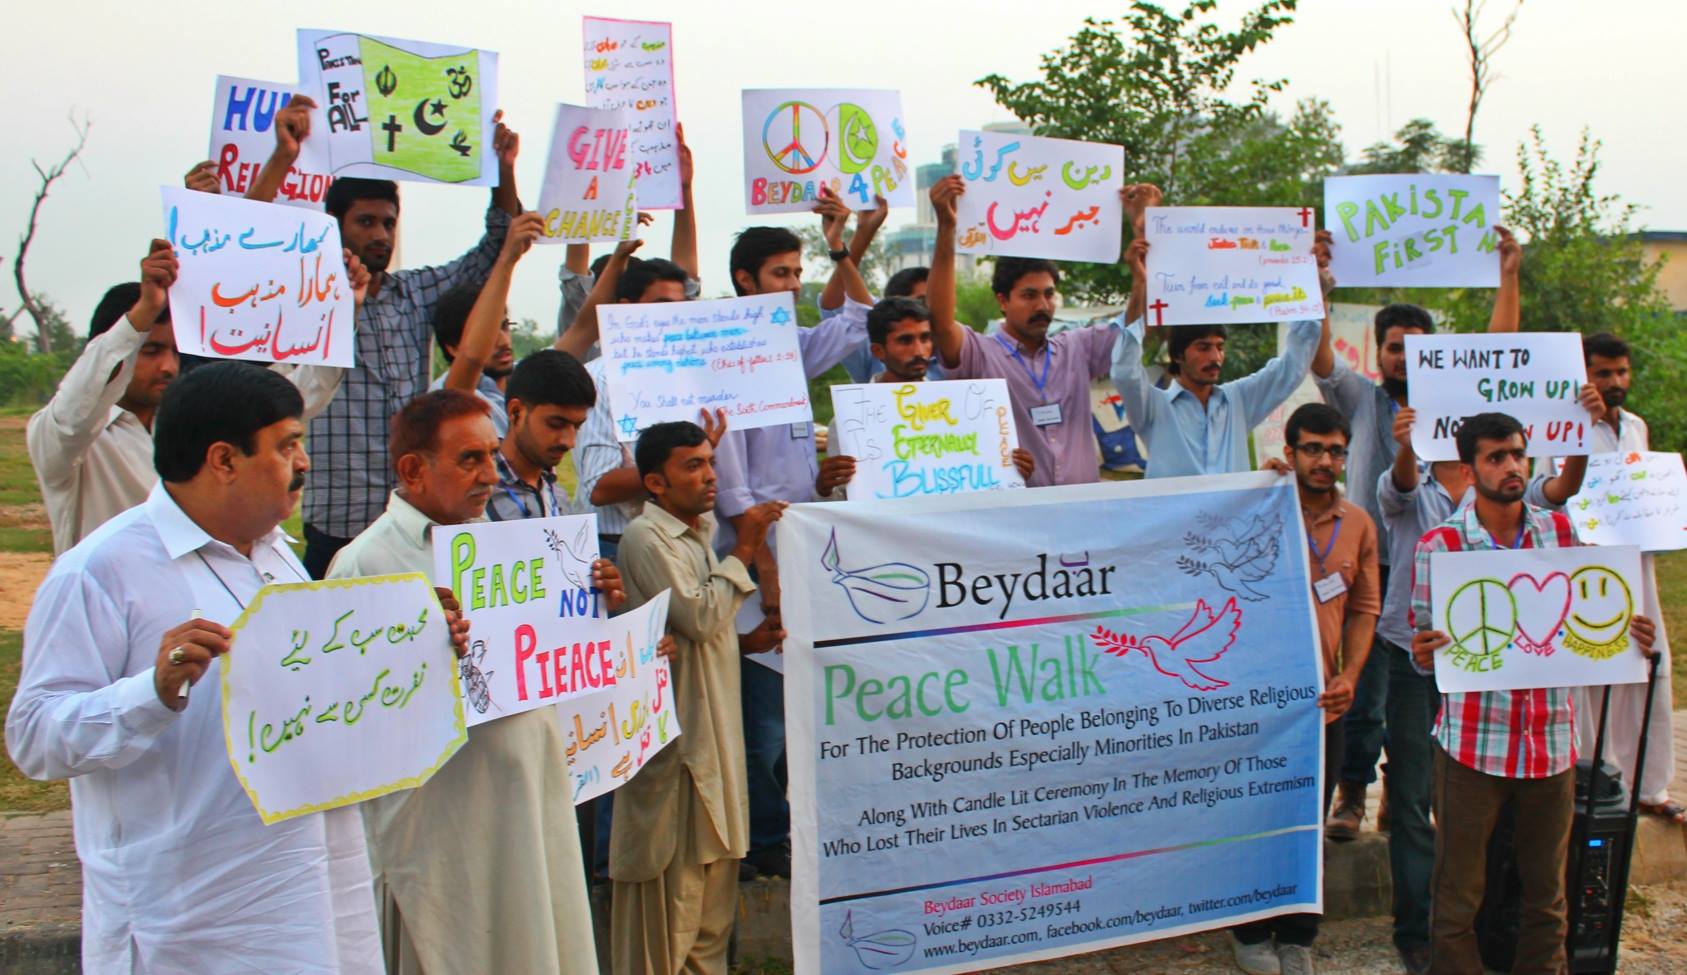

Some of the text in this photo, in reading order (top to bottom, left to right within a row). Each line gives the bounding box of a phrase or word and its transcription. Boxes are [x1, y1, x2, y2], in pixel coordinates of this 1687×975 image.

[223, 86, 293, 133] HU
[567, 126, 628, 172] GIVE
[961, 135, 1112, 191] دین میں کوئی
[217, 143, 336, 203] REGIO
[582, 175, 599, 201] A
[847, 172, 869, 204] 4
[544, 207, 622, 241] CHANCE
[986, 190, 1101, 242] جبر نہیں
[210, 252, 341, 314] ہمارا مذہب
[1418, 349, 1531, 370] WE WANT TO
[892, 383, 959, 432] GIVER
[1477, 378, 1580, 404] GROW UP!
[1432, 415, 1466, 440] NO
[1545, 420, 1584, 448] UP!
[450, 531, 546, 611] PEACE
[933, 552, 1116, 621] Beydaar
[386, 608, 428, 645] محبت
[559, 587, 602, 619] NOT
[321, 608, 355, 655] کے
[349, 627, 385, 656] سب
[1443, 634, 1629, 673] PEACE LOVE HAPPINESS
[343, 668, 390, 726] کسی
[380, 661, 428, 710] نفرت
[823, 632, 1107, 727] Peace Walk
[314, 701, 339, 724] سے
[564, 701, 620, 767] انسانی
[820, 684, 1317, 761] For The Protection Of People Belonging To Diverse Religious
[892, 719, 1260, 782] Backgrounds Especially Minorities In Pakistan
[857, 754, 1289, 828] Along With Candle Lit Ceremony In The Memory Of Those
[823, 773, 1316, 858] Who Lost Their Lives In Sectarian Violence And Religious Extremism
[922, 898, 1082, 937] Voice# 0332-5249544
[923, 875, 1094, 918] Beydaar Society Islamabad
[1187, 882, 1299, 915] twitter.com/beydaar
